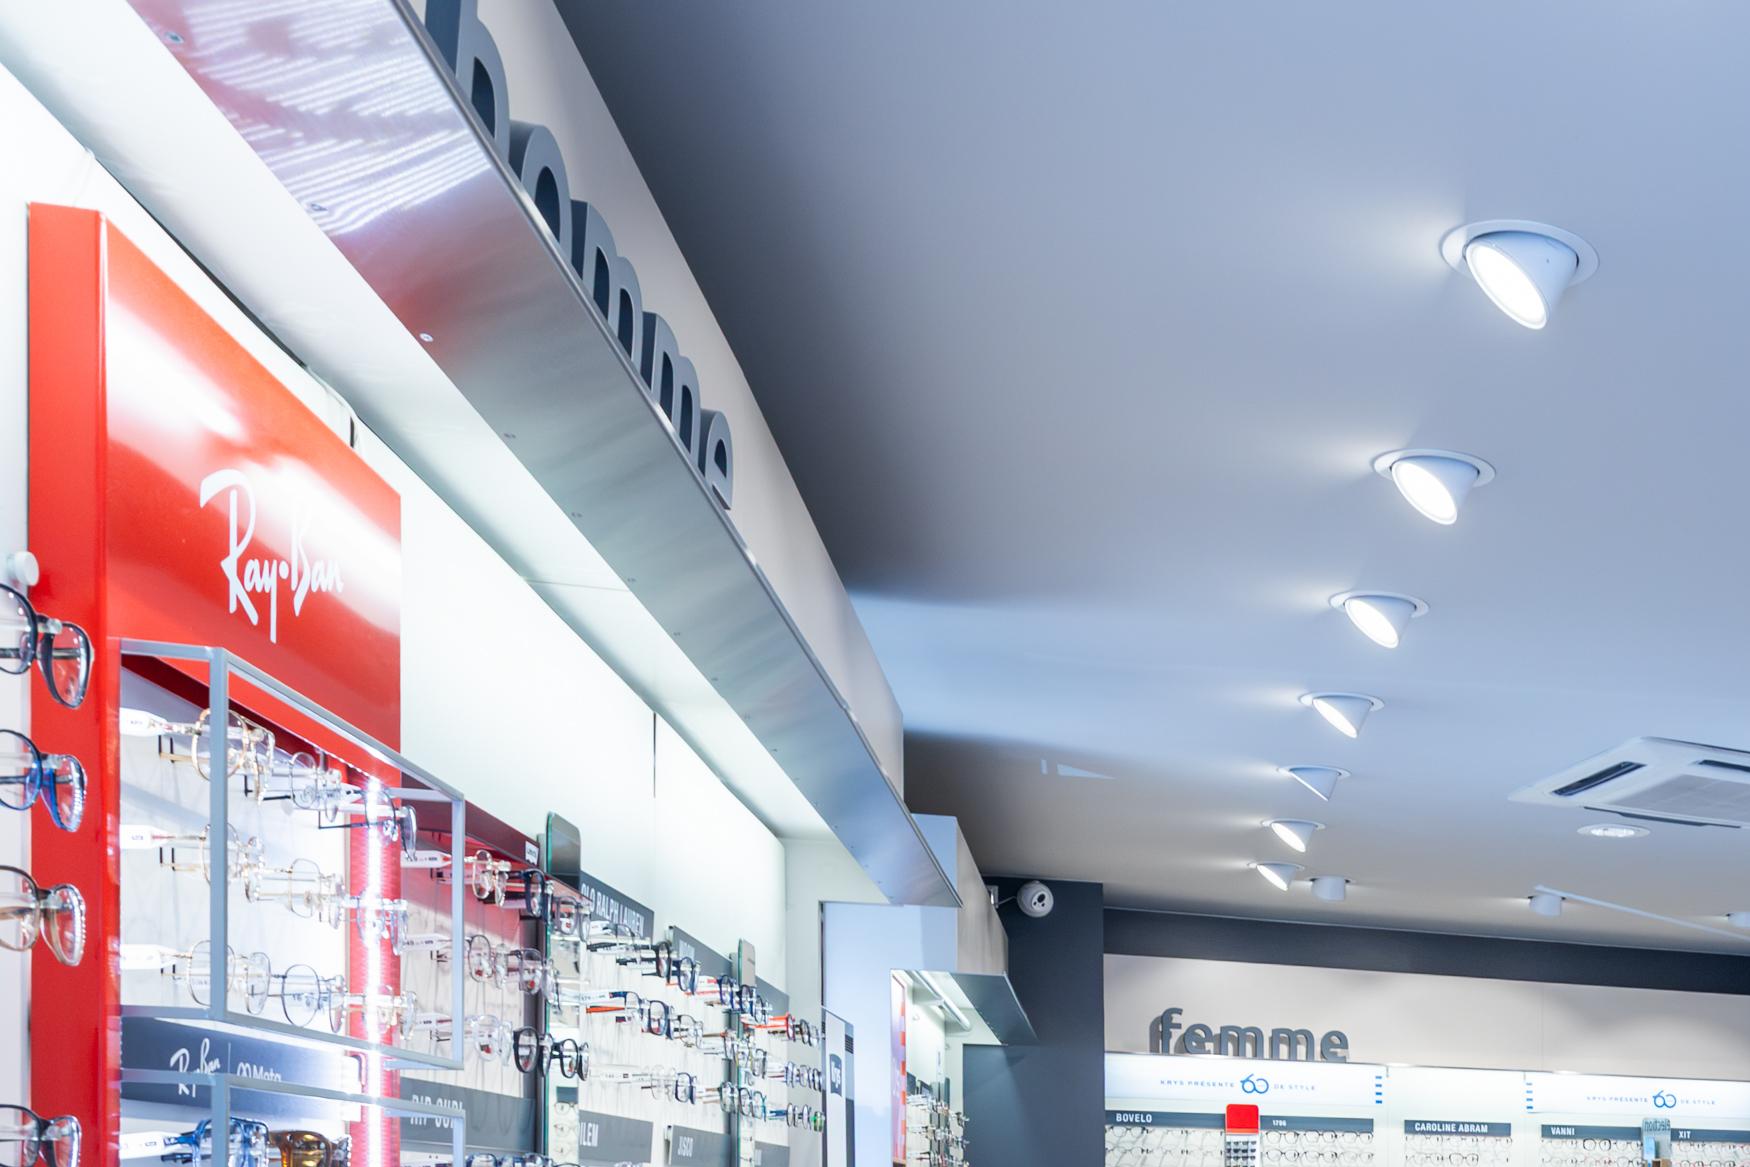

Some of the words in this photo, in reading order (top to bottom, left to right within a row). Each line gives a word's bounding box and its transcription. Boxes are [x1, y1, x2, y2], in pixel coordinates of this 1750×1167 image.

[1161, 1008, 1349, 1062] femme
[1116, 1113, 1152, 1124] BOVELO
[1415, 1123, 1456, 1132] CAROLINE
[1458, 1124, 1488, 1133] ABRAM
[1551, 1127, 1575, 1136] VANNI
[1678, 1131, 1691, 1139] XIT
